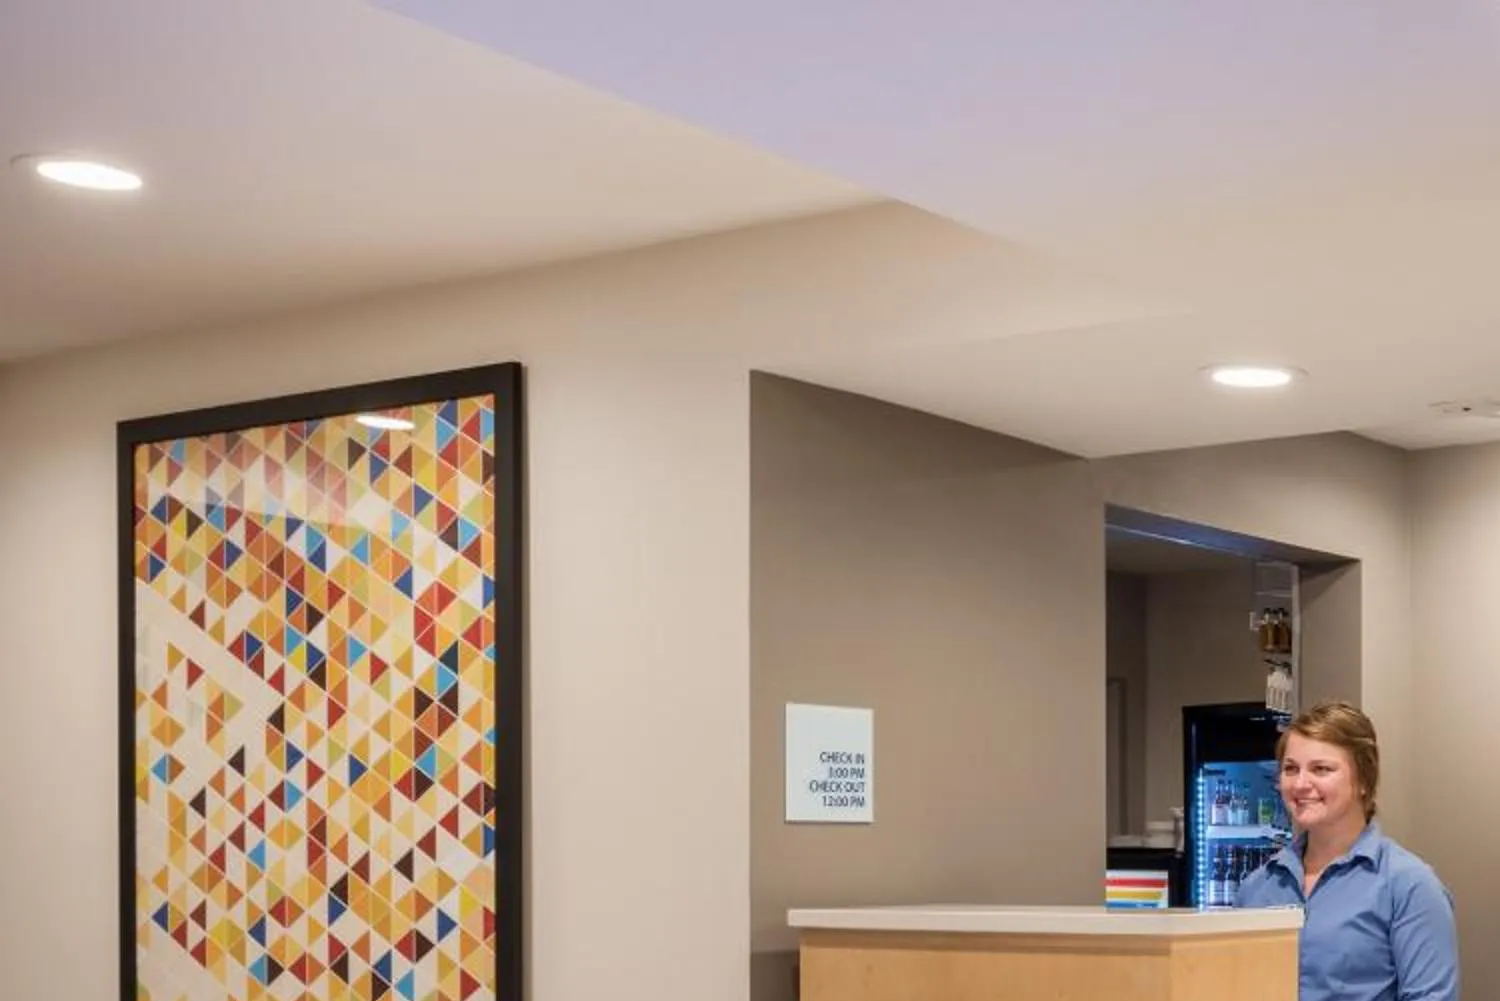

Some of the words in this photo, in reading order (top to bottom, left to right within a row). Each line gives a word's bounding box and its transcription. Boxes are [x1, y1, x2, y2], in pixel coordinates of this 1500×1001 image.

[819, 751, 852, 764] CHECK
[855, 752, 865, 764] IN
[850, 767, 865, 779] PM
[809, 780, 843, 793] CHECK
[844, 781, 866, 793] OUT
[822, 795, 849, 808] 12:00
[850, 795, 865, 808] PM
